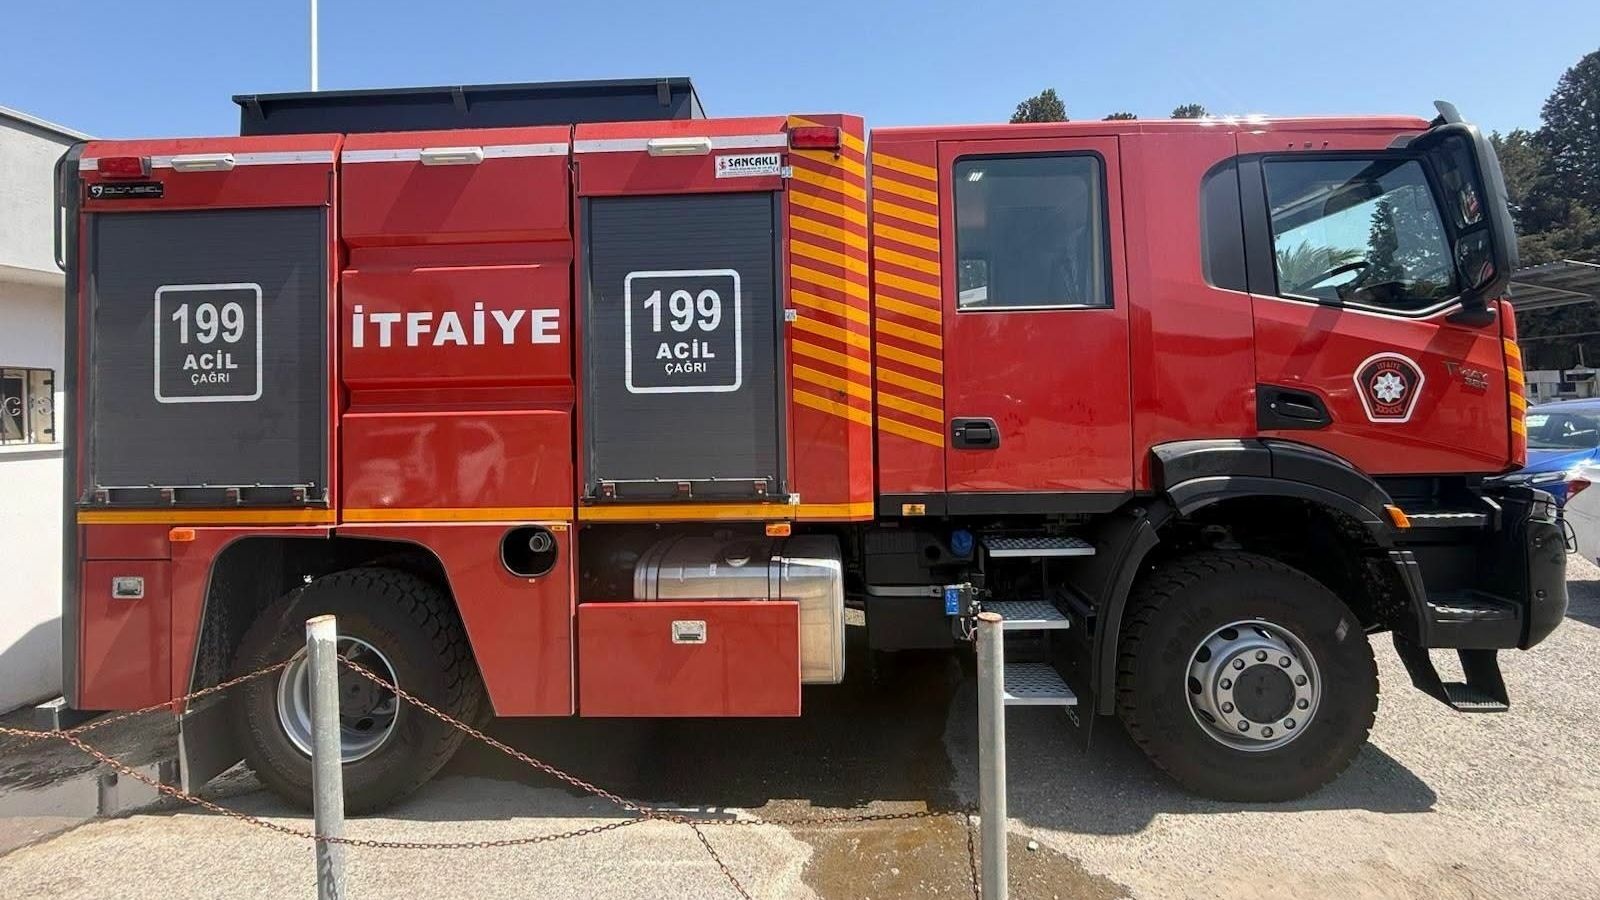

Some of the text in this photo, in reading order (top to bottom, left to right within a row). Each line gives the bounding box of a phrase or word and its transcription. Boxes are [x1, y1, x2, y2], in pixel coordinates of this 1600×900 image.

[728, 156, 778, 167] SANCAKLI
[643, 289, 721, 332] 199
[172, 302, 245, 344] 199
[352, 302, 561, 348] İTFAİYE
[656, 339, 716, 359] ACİL
[183, 349, 239, 370] ACİL
[665, 360, 707, 375] ÇAĞRI
[191, 371, 230, 386] ÇAĞRI
